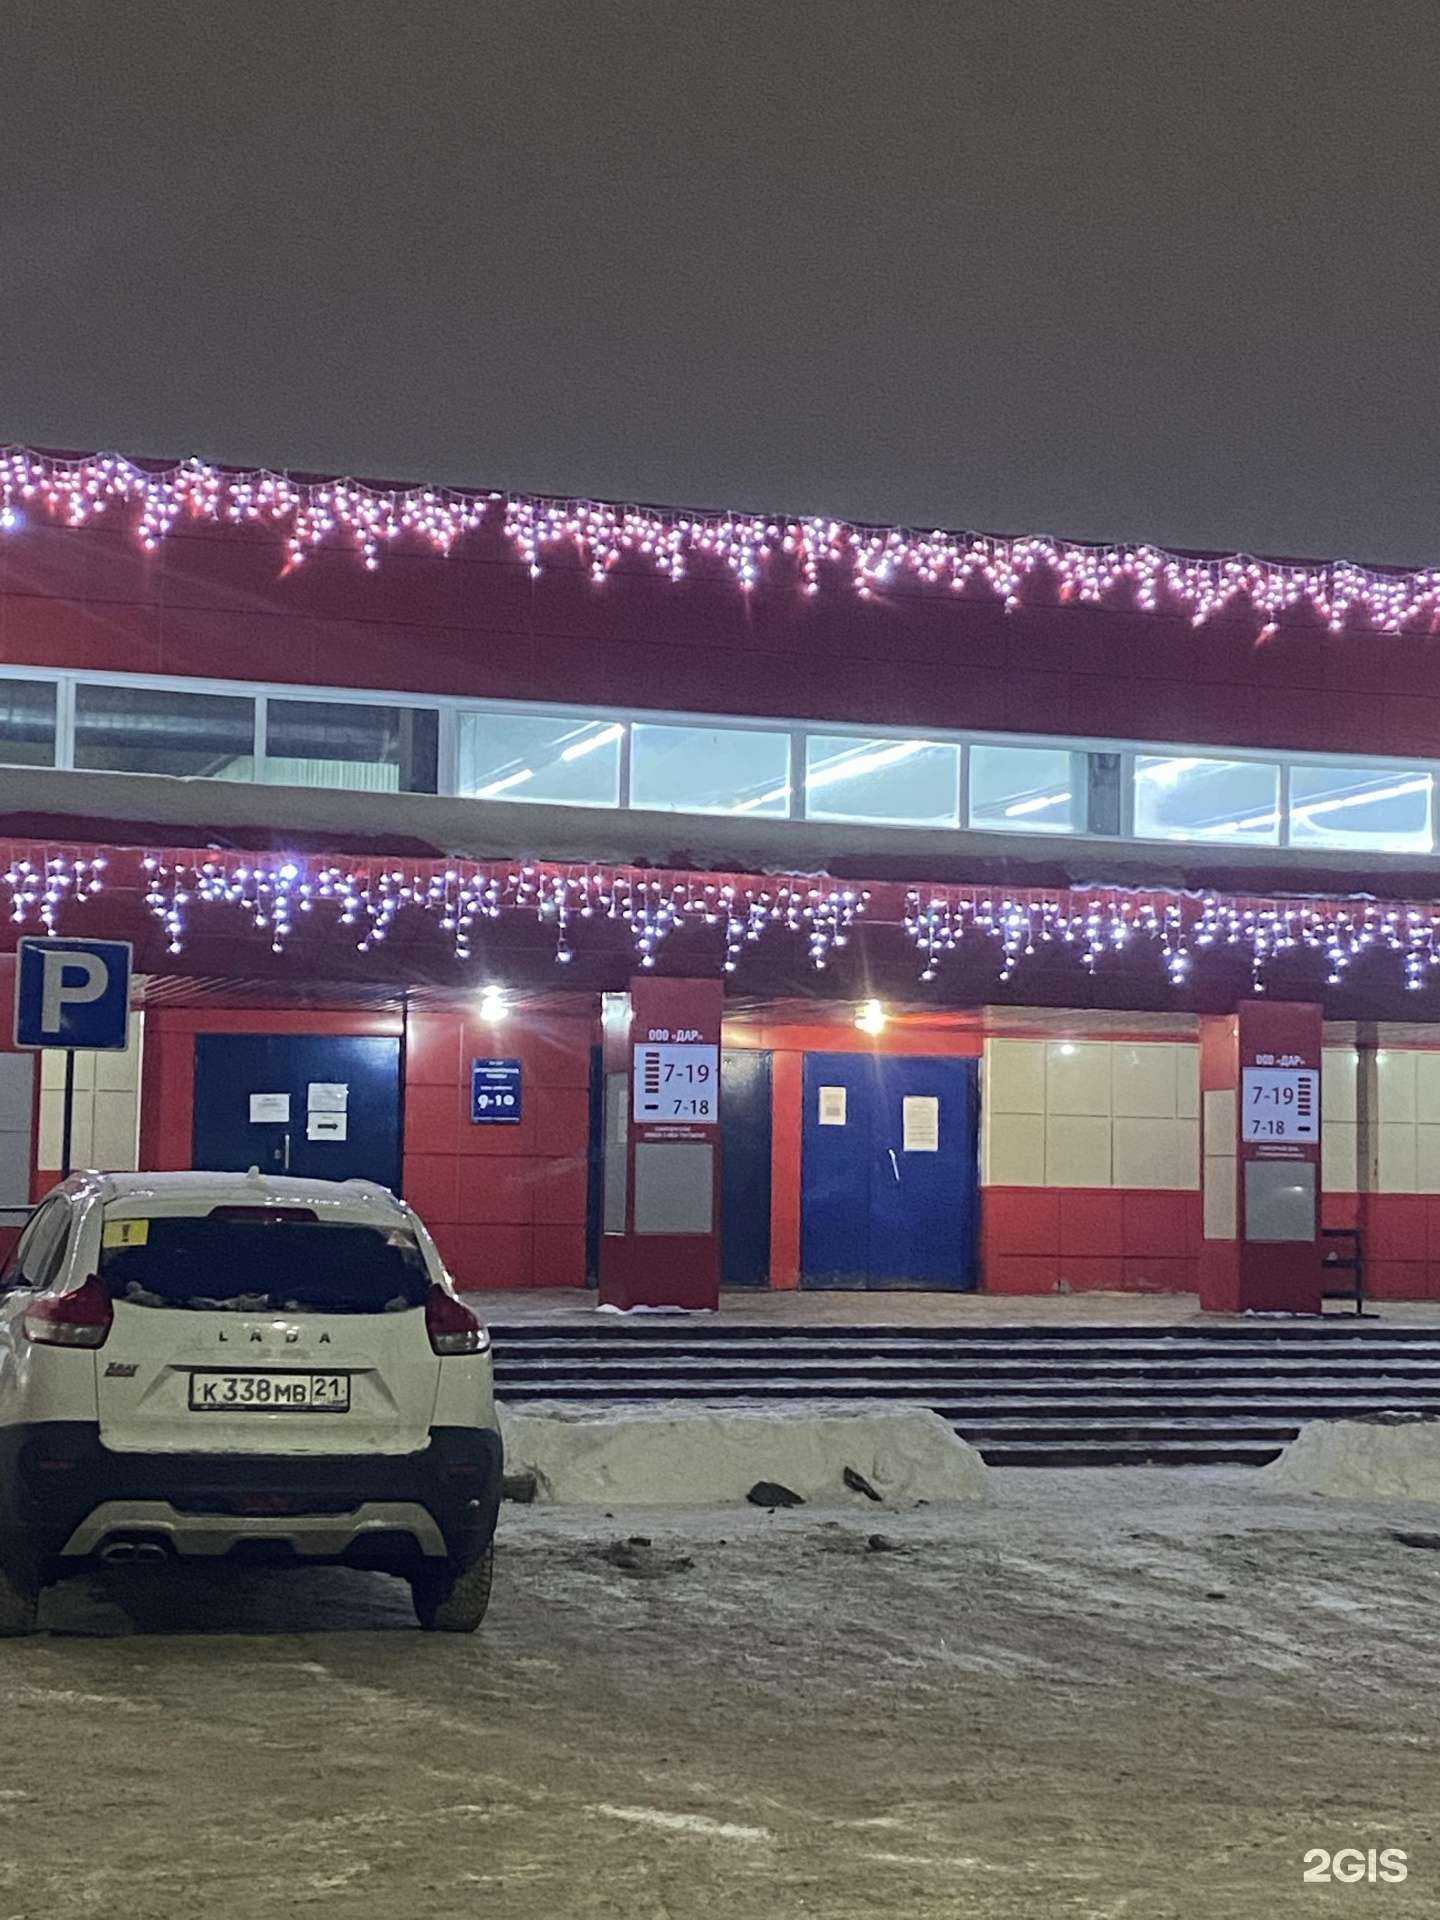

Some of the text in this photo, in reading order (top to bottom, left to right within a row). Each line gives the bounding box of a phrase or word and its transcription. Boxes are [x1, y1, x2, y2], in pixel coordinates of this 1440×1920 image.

[41, 950, 109, 1033] P
[648, 1029, 669, 1041] ООО
[664, 1064, 709, 1083] 7-19
[1252, 1086, 1294, 1105] 7-19
[673, 1099, 709, 1115] 7-18
[1252, 1120, 1285, 1135] 7-18
[218, 1330, 331, 1343] LADA
